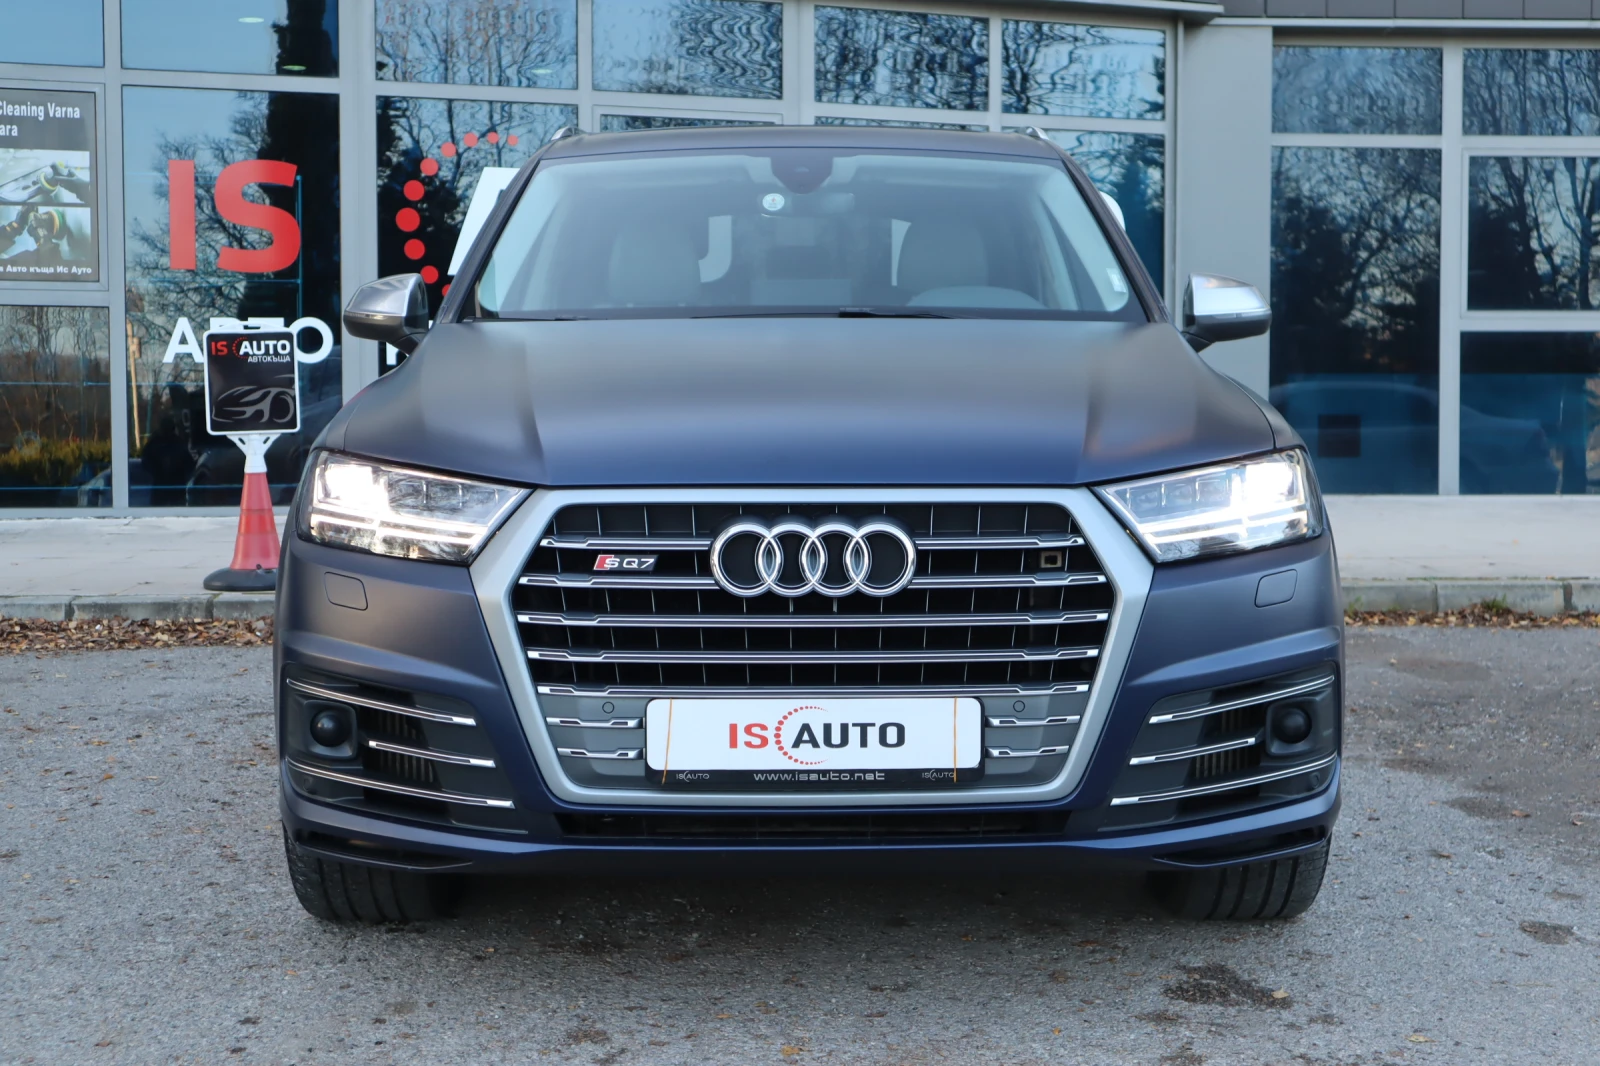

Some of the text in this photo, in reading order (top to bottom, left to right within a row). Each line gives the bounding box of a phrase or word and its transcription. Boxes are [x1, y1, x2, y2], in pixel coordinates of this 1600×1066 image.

[48, 102, 80, 118] Varna
[168, 159, 302, 273] IS
[6, 265, 27, 273] Авто
[71, 266, 92, 275] Ауто
[211, 340, 291, 356] IS AUTO
[248, 355, 291, 363] АВТОКЪЩА
[603, 558, 655, 569] SQ7
[729, 722, 906, 749] IS AUTO
[753, 771, 886, 781] www.isauto.net
